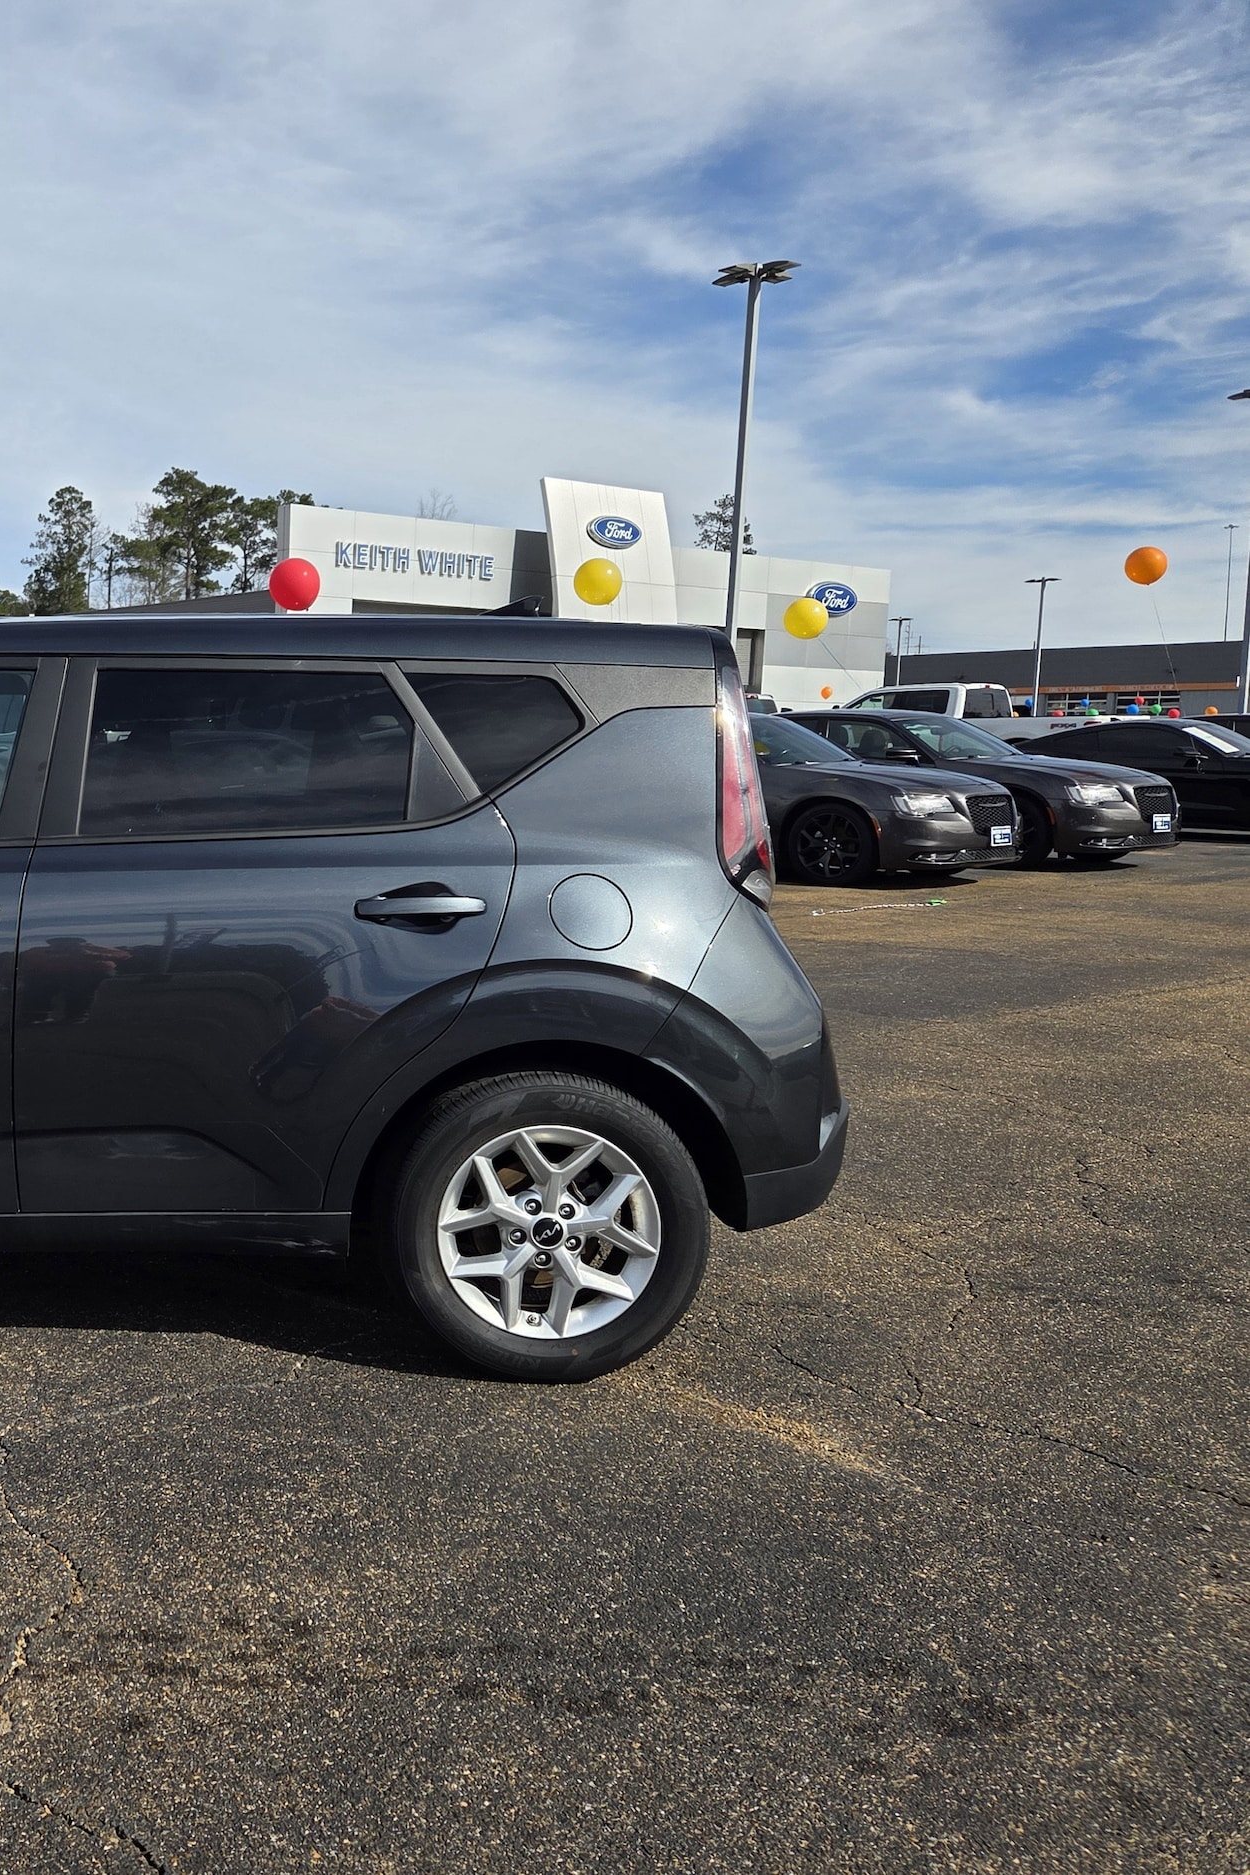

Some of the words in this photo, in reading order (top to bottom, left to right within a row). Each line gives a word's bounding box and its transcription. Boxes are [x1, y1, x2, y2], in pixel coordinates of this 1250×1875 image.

[605, 521, 633, 540] Ford
[335, 541, 411, 573] KEITH
[417, 549, 495, 581] WHITE
[822, 588, 850, 609] Ford
